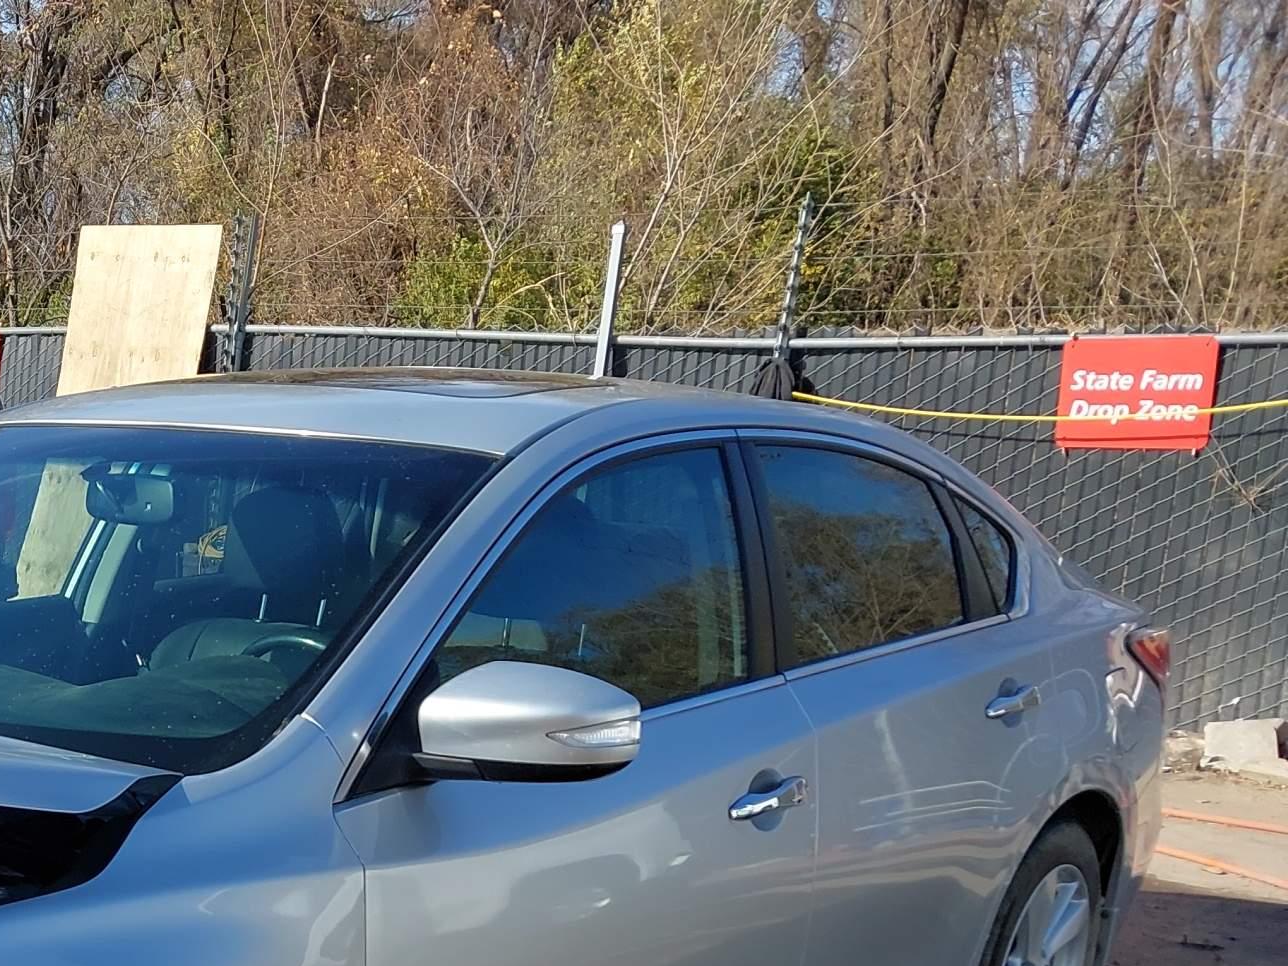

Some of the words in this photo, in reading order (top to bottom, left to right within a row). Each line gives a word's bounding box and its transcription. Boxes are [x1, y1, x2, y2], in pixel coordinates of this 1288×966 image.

[1070, 369, 1134, 391] State
[1139, 369, 1204, 391] Farm
[1069, 400, 1130, 425] Drop
[1135, 400, 1199, 421] Zone
